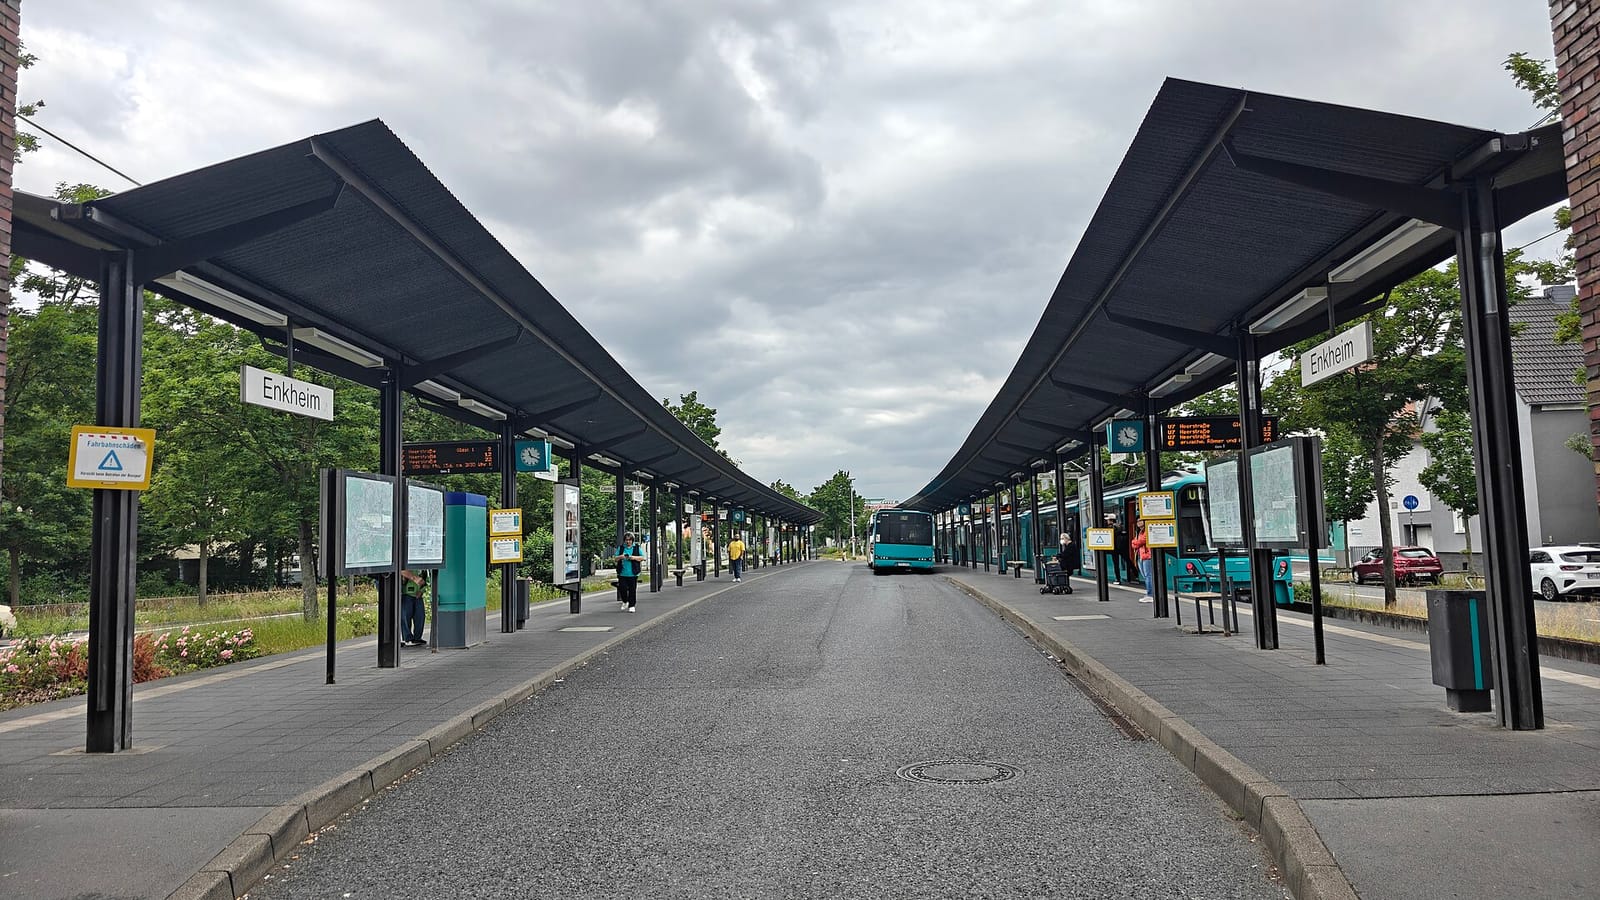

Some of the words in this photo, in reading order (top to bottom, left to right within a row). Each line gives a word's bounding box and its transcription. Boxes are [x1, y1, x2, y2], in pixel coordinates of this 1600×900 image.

[1310, 339, 1354, 375] Enkheim
[263, 376, 321, 411] Enkheim
[87, 440, 142, 449] Fahrbahnschäden
